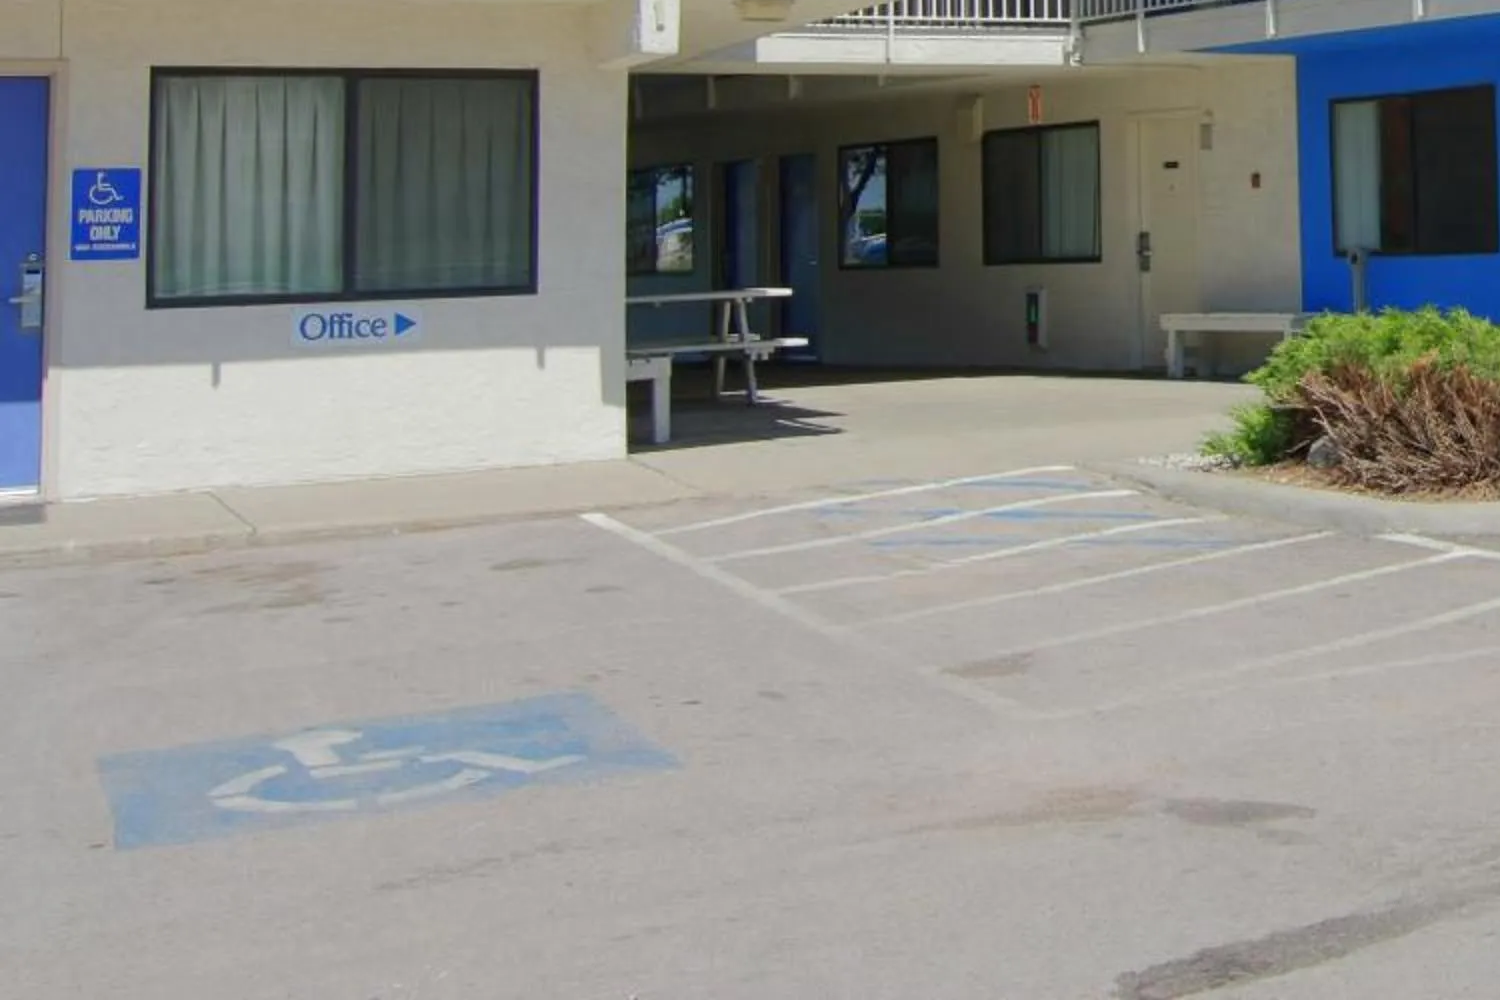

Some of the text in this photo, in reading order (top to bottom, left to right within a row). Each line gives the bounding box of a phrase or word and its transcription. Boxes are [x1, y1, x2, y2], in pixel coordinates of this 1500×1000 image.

[79, 208, 133, 224] PARKING
[90, 224, 121, 241] ONLY
[300, 312, 387, 340] Office
